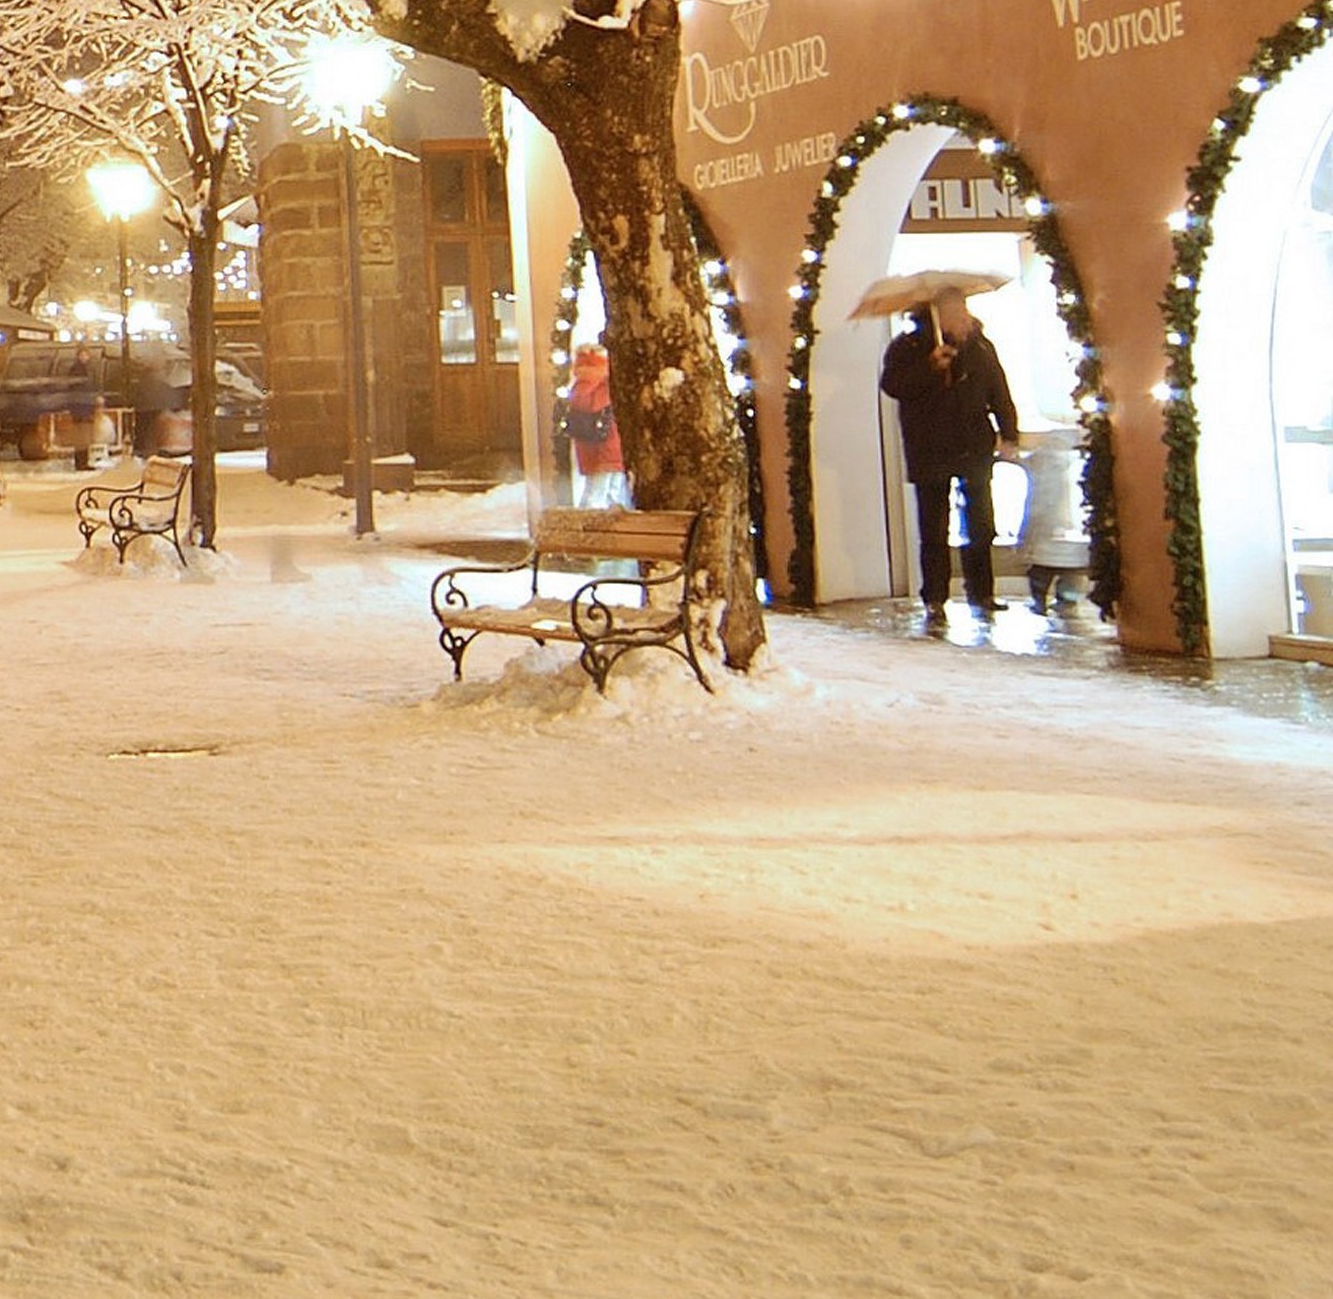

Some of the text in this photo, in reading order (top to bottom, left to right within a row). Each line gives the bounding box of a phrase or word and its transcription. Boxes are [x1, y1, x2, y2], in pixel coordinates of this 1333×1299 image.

[1074, 0, 1184, 61] BOUTIQUE
[684, 35, 831, 144] RUNGGALDIER
[773, 132, 837, 173] JUWELIER
